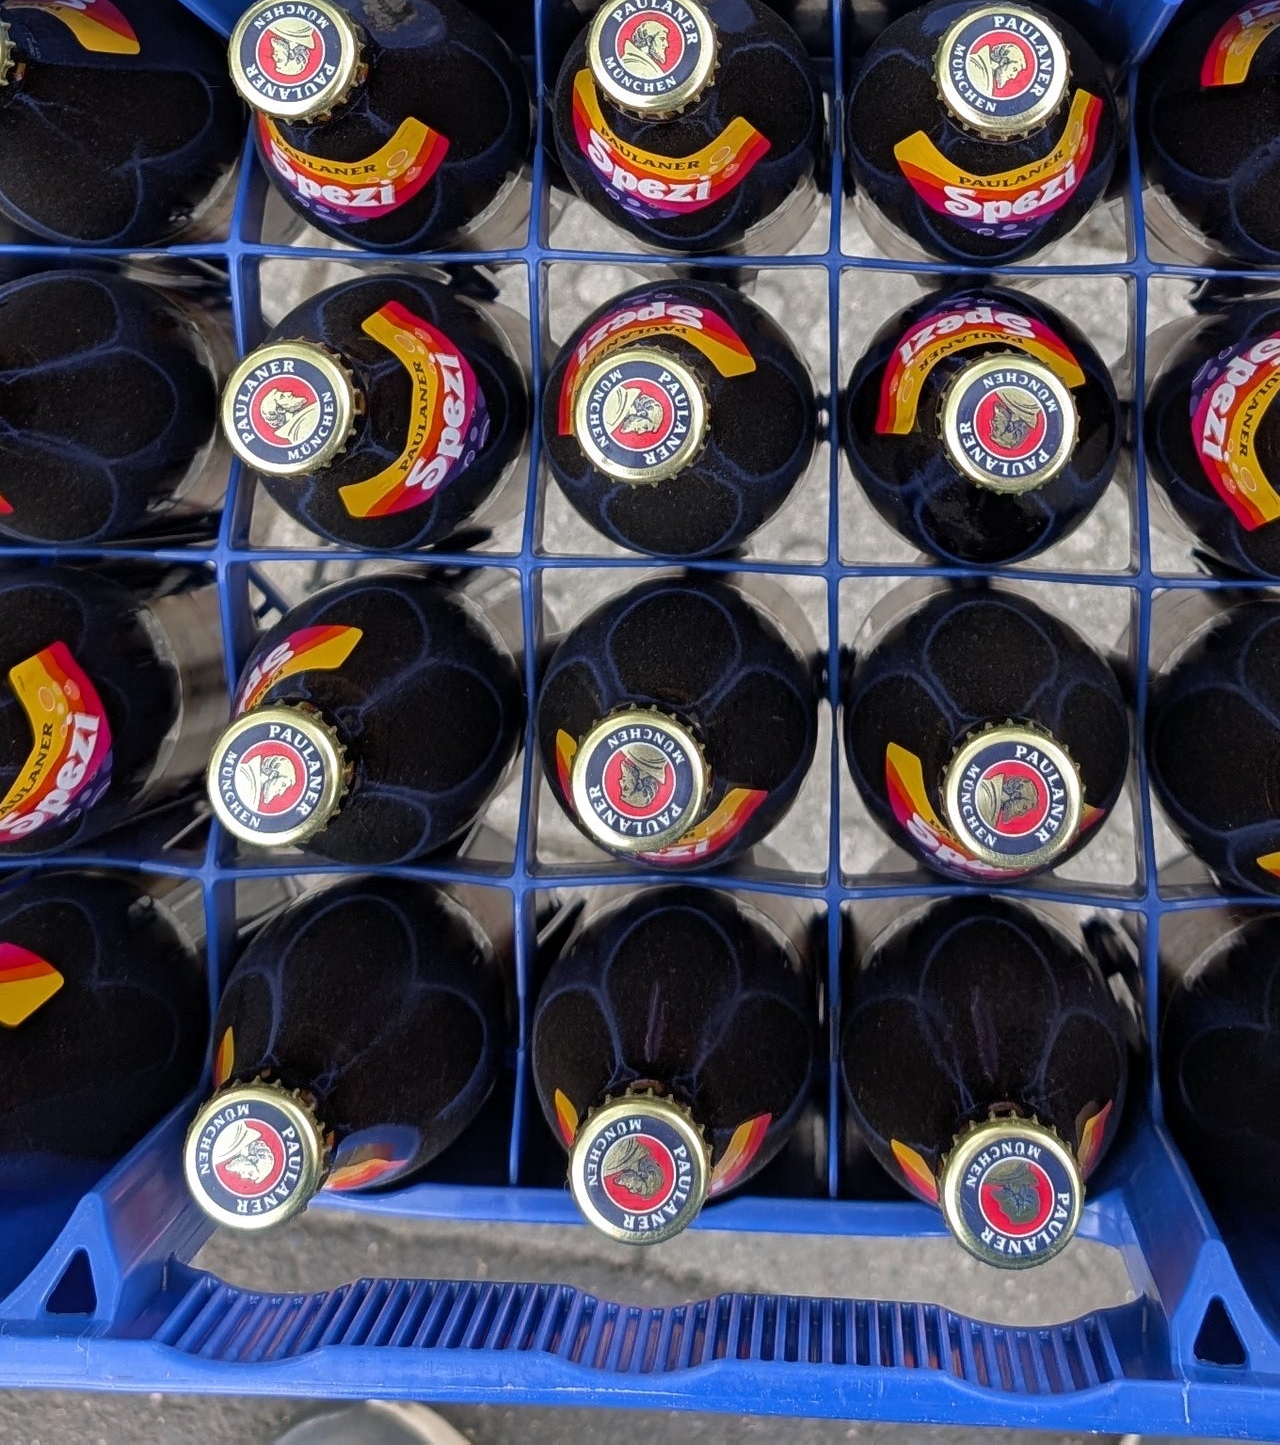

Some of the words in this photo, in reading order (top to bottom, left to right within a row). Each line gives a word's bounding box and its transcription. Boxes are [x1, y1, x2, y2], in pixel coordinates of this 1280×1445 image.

[253, 3, 330, 30] MÜNCHEN
[245, 61, 337, 101] PAULANER
[604, 55, 678, 93] MÜNCHEN
[951, 42, 998, 113] MÜNCHEN
[992, 15, 1053, 97] PAULANER
[271, 138, 396, 207] Spezi
[276, 136, 379, 177] PAULANER
[587, 128, 712, 202] Spezi
[600, 125, 701, 171] PAULANER
[958, 149, 1065, 188] PAULANER
[943, 158, 1077, 224] Spezi
[577, 302, 705, 365] Spezi
[898, 306, 1036, 369] Spezi
[918, 331, 1024, 373] PAULANER
[234, 359, 296, 446] PAULANER
[286, 390, 335, 462] MÜNCHEN
[398, 360, 428, 472] PAULANER
[405, 352, 466, 491] Spezi
[588, 368, 624, 449] MÜNCHEN
[642, 370, 690, 466] PAULANER
[981, 371, 1059, 414] MÜNCHEN
[958, 420, 1051, 476] PAULANER
[268, 724, 323, 816] PAULANER
[606, 727, 686, 766] MÜNCHEN
[221, 750, 261, 828] MÜNCHEN
[587, 783, 683, 836] PAULANER
[960, 763, 998, 848] MÜNCHEN
[1014, 744, 1065, 844] PAULANER
[199, 1103, 250, 1175] MÜNCHEN
[236, 1125, 302, 1213] PAULANER
[586, 1118, 642, 1186] MÜNCHEN
[965, 1141, 1042, 1189] MÜNCHEN
[622, 1143, 692, 1230] PAULANER
[980, 1192, 1071, 1255] PAULANER
